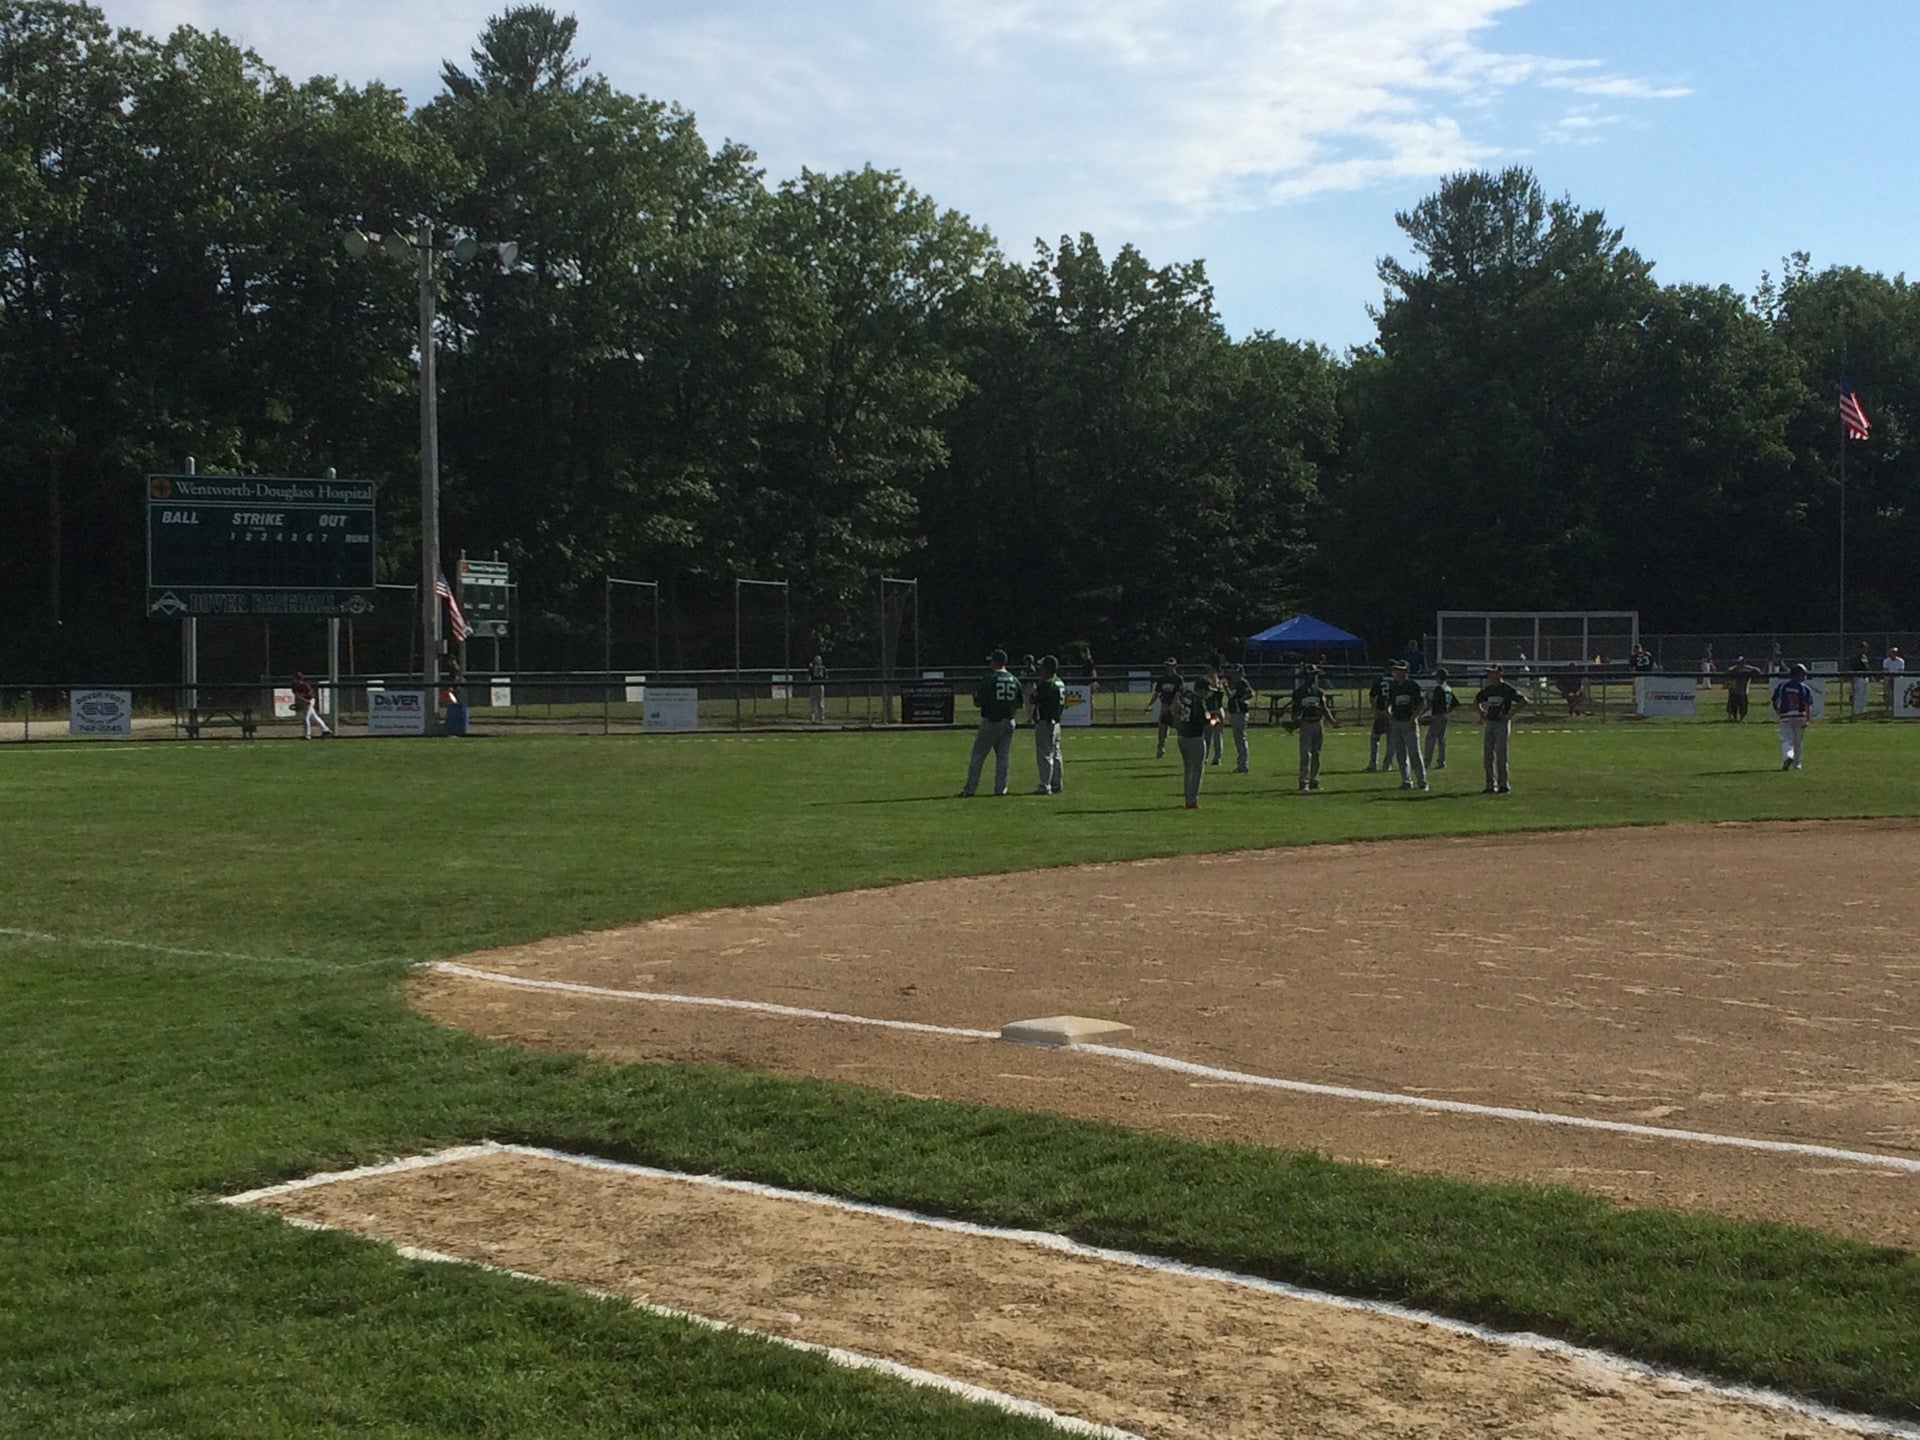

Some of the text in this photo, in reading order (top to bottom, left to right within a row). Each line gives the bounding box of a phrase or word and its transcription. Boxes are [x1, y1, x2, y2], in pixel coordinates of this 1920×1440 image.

[176, 481, 372, 502] Wentworth-Douglass Hospital
[161, 511, 348, 527] BALL STRIKE OUT
[230, 532, 236, 541] 1
[244, 533, 252, 541] 2
[260, 533, 268, 541] 3
[275, 533, 283, 541] 4
[290, 533, 298, 541] 5
[306, 533, 314, 542] 6
[321, 533, 329, 542] 7
[189, 593, 339, 614] DOVER BASEBALL
[1636, 655, 1650, 667] 23
[996, 682, 1015, 701] 25
